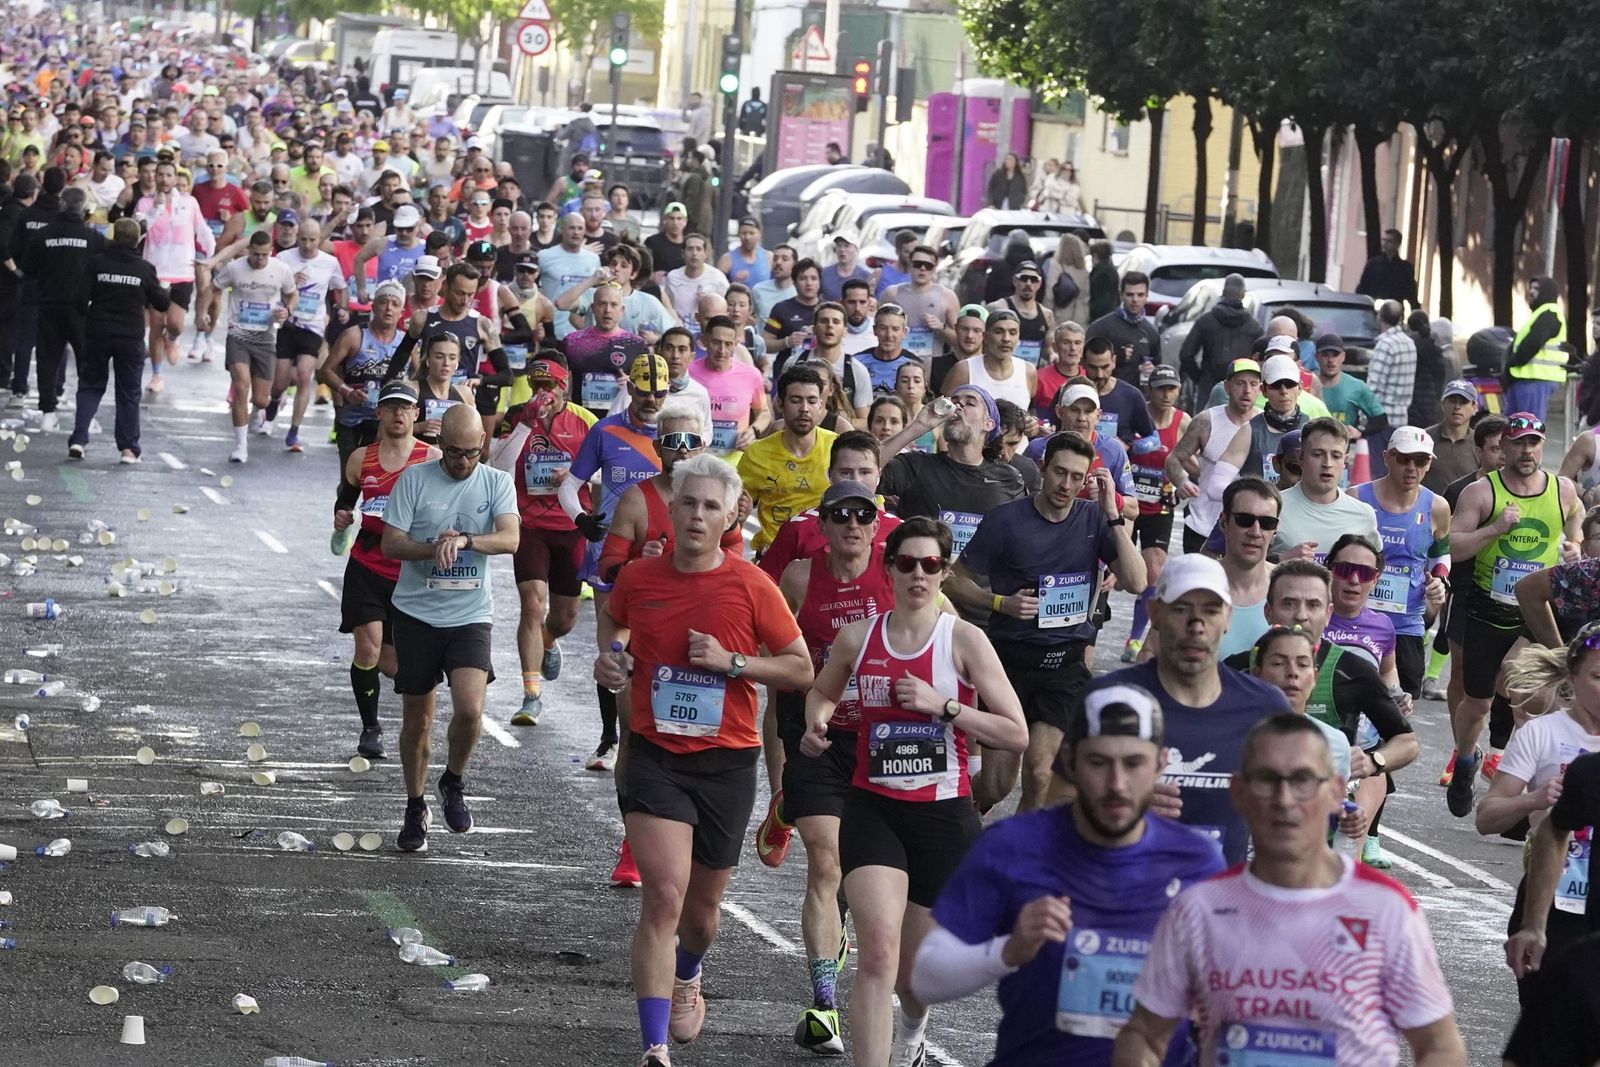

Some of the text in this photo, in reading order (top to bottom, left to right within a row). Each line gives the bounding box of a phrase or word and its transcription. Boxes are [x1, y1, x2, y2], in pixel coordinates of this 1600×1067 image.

[525, 32, 545, 45] 30
[45, 237, 88, 248] VOLUNTEER
[97, 273, 142, 286] VOLUNTEER
[1140, 468, 1163, 476] ZURICH
[1509, 535, 1539, 543] INTERIA
[431, 566, 478, 577] ALBERTO
[1511, 562, 1540, 571] ZURICH
[1058, 575, 1086, 585] ZURICH
[1060, 592, 1074, 600] 8714
[1369, 588, 1394, 600] LUIGI
[829, 599, 864, 610] GENERALI
[1045, 601, 1084, 615] QUENTIN
[1327, 629, 1359, 641] Vibes
[676, 672, 717, 685] ZURICH
[860, 675, 891, 688] HYDE
[675, 691, 697, 703] 5787
[861, 688, 891, 701] PARK
[670, 705, 698, 720] EDD
[894, 726, 937, 736] ZURICH
[895, 745, 919, 754] 4966
[882, 758, 933, 774] HONOR
[1235, 996, 1320, 1020] TRAIL
[1254, 1030, 1324, 1051] ZURICH
